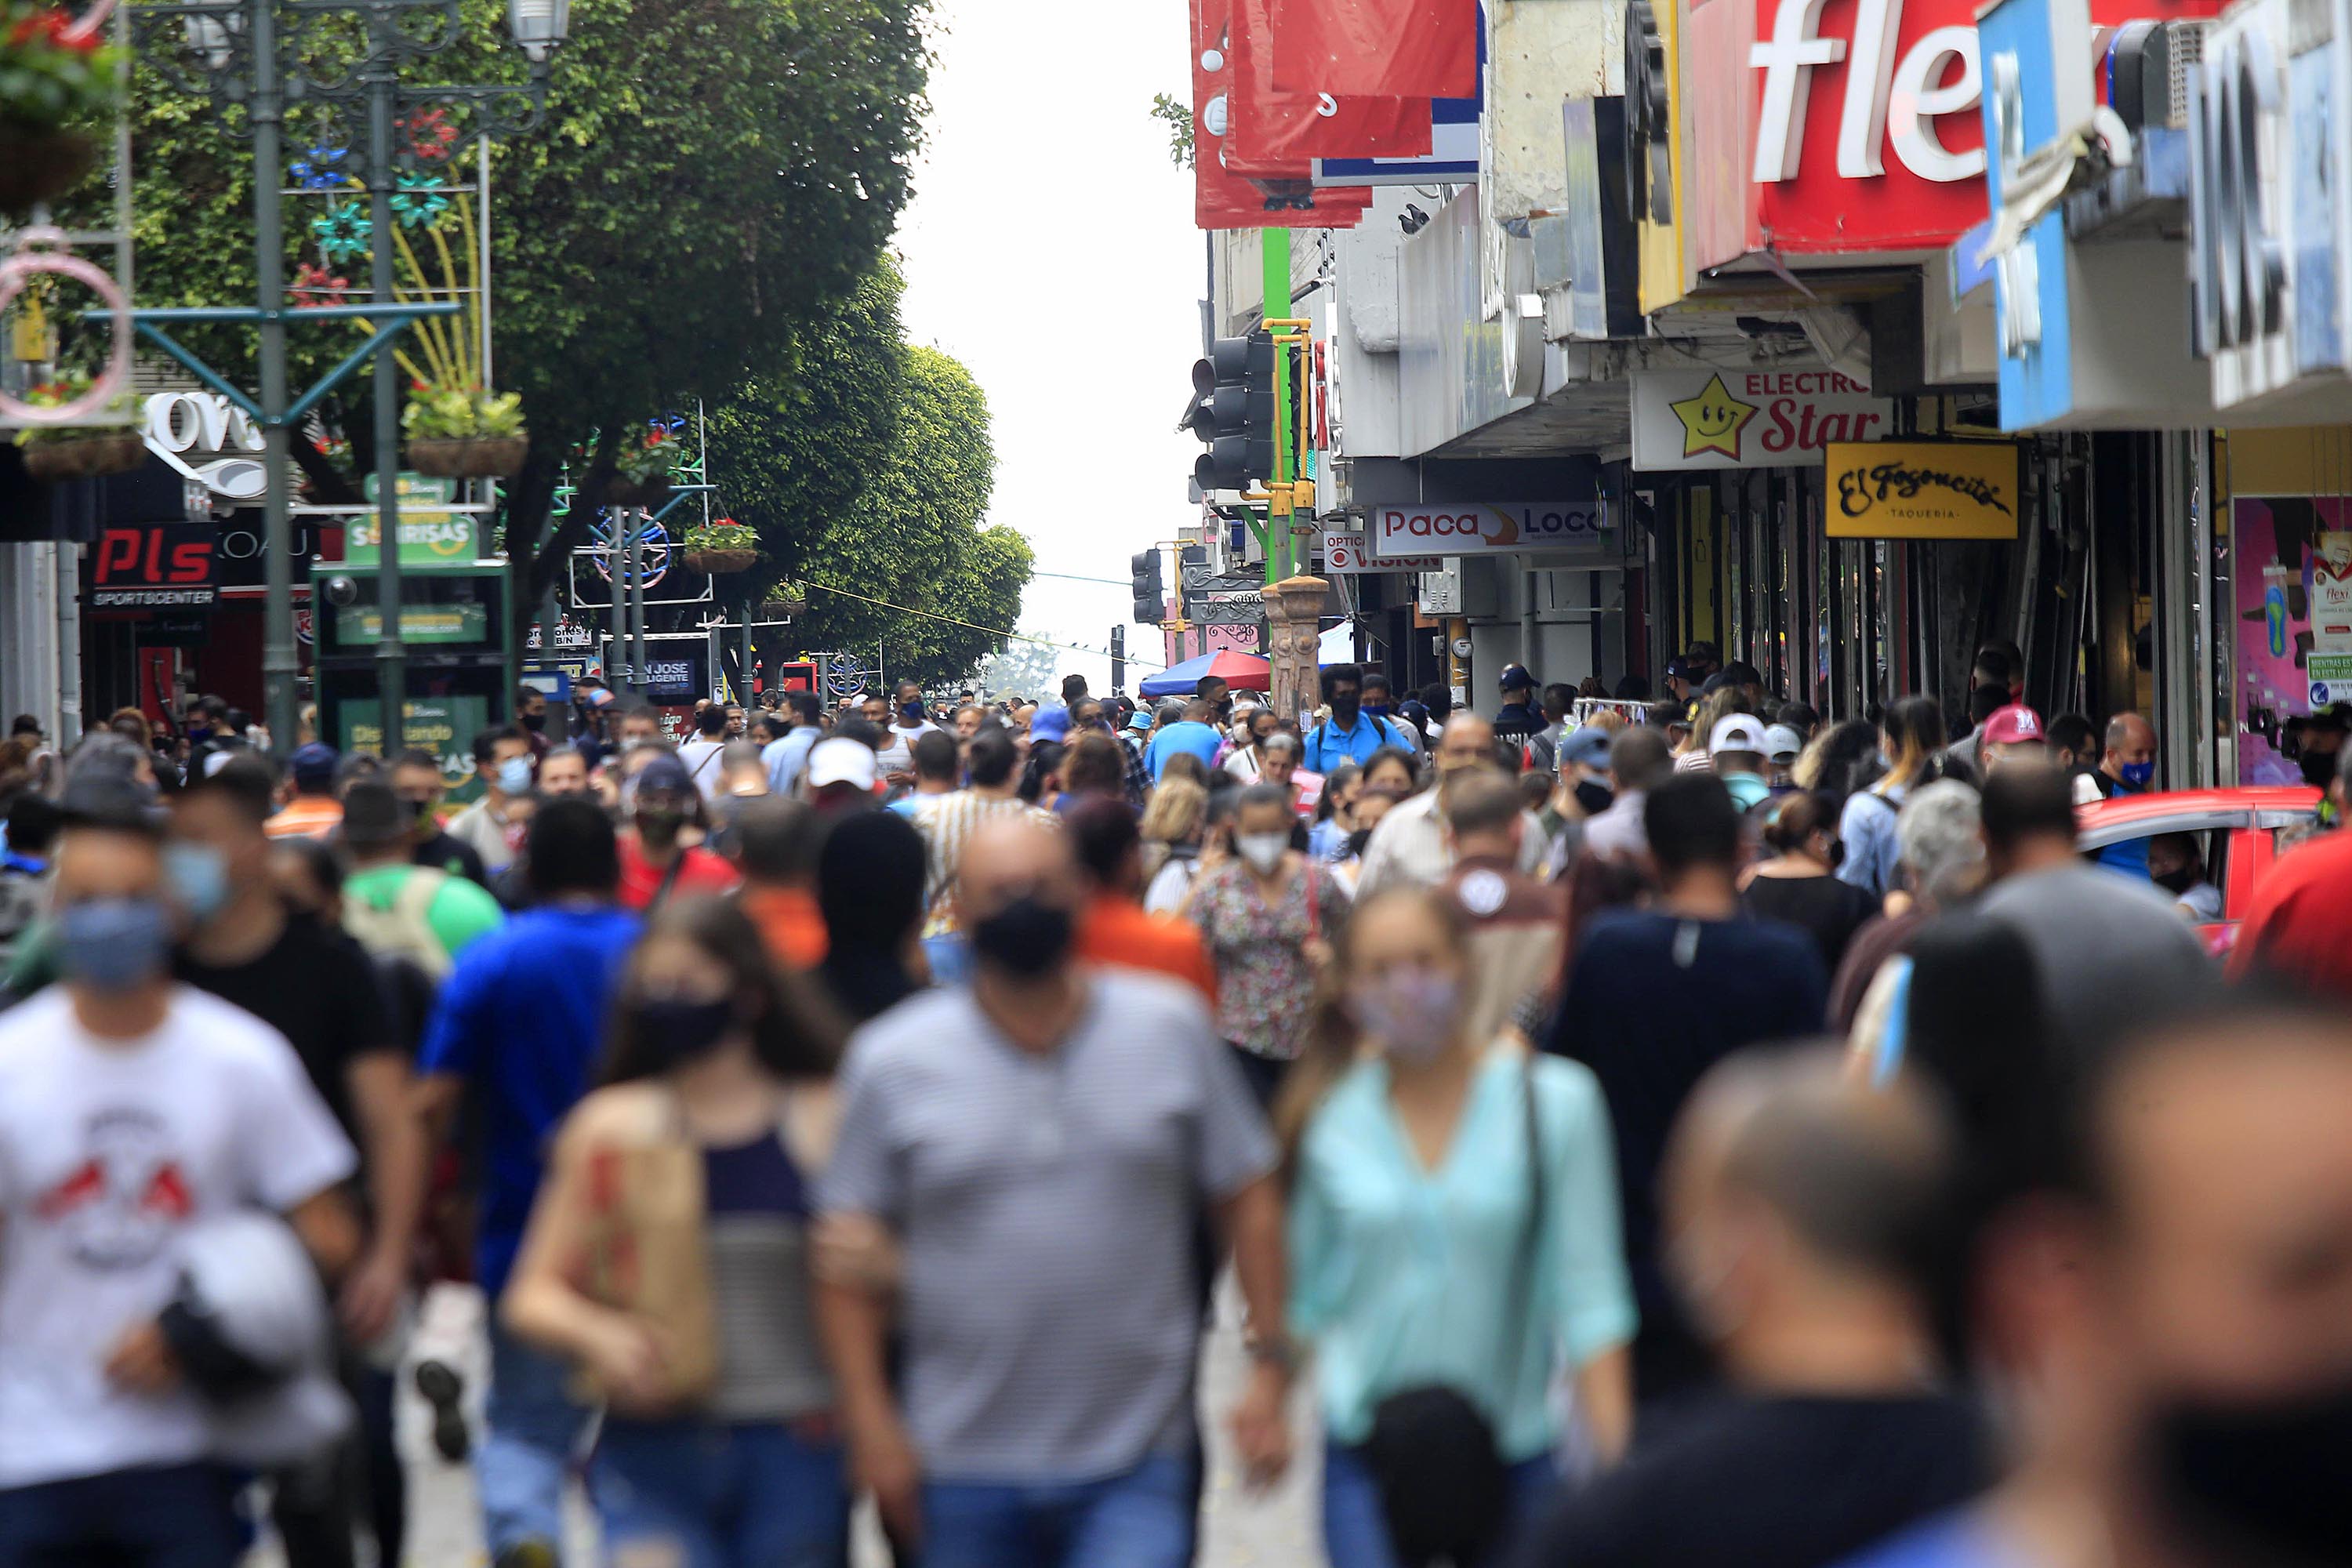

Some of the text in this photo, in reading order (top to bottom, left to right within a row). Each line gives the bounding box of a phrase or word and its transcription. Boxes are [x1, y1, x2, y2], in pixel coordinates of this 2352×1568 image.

[1762, 398, 1880, 452] Star
[1838, 468, 1872, 518] El
[1385, 511, 1479, 538] Paca
[94, 528, 214, 584] Pls
[93, 590, 214, 606] SPORTSCENTER
[626, 664, 652, 674] SN
